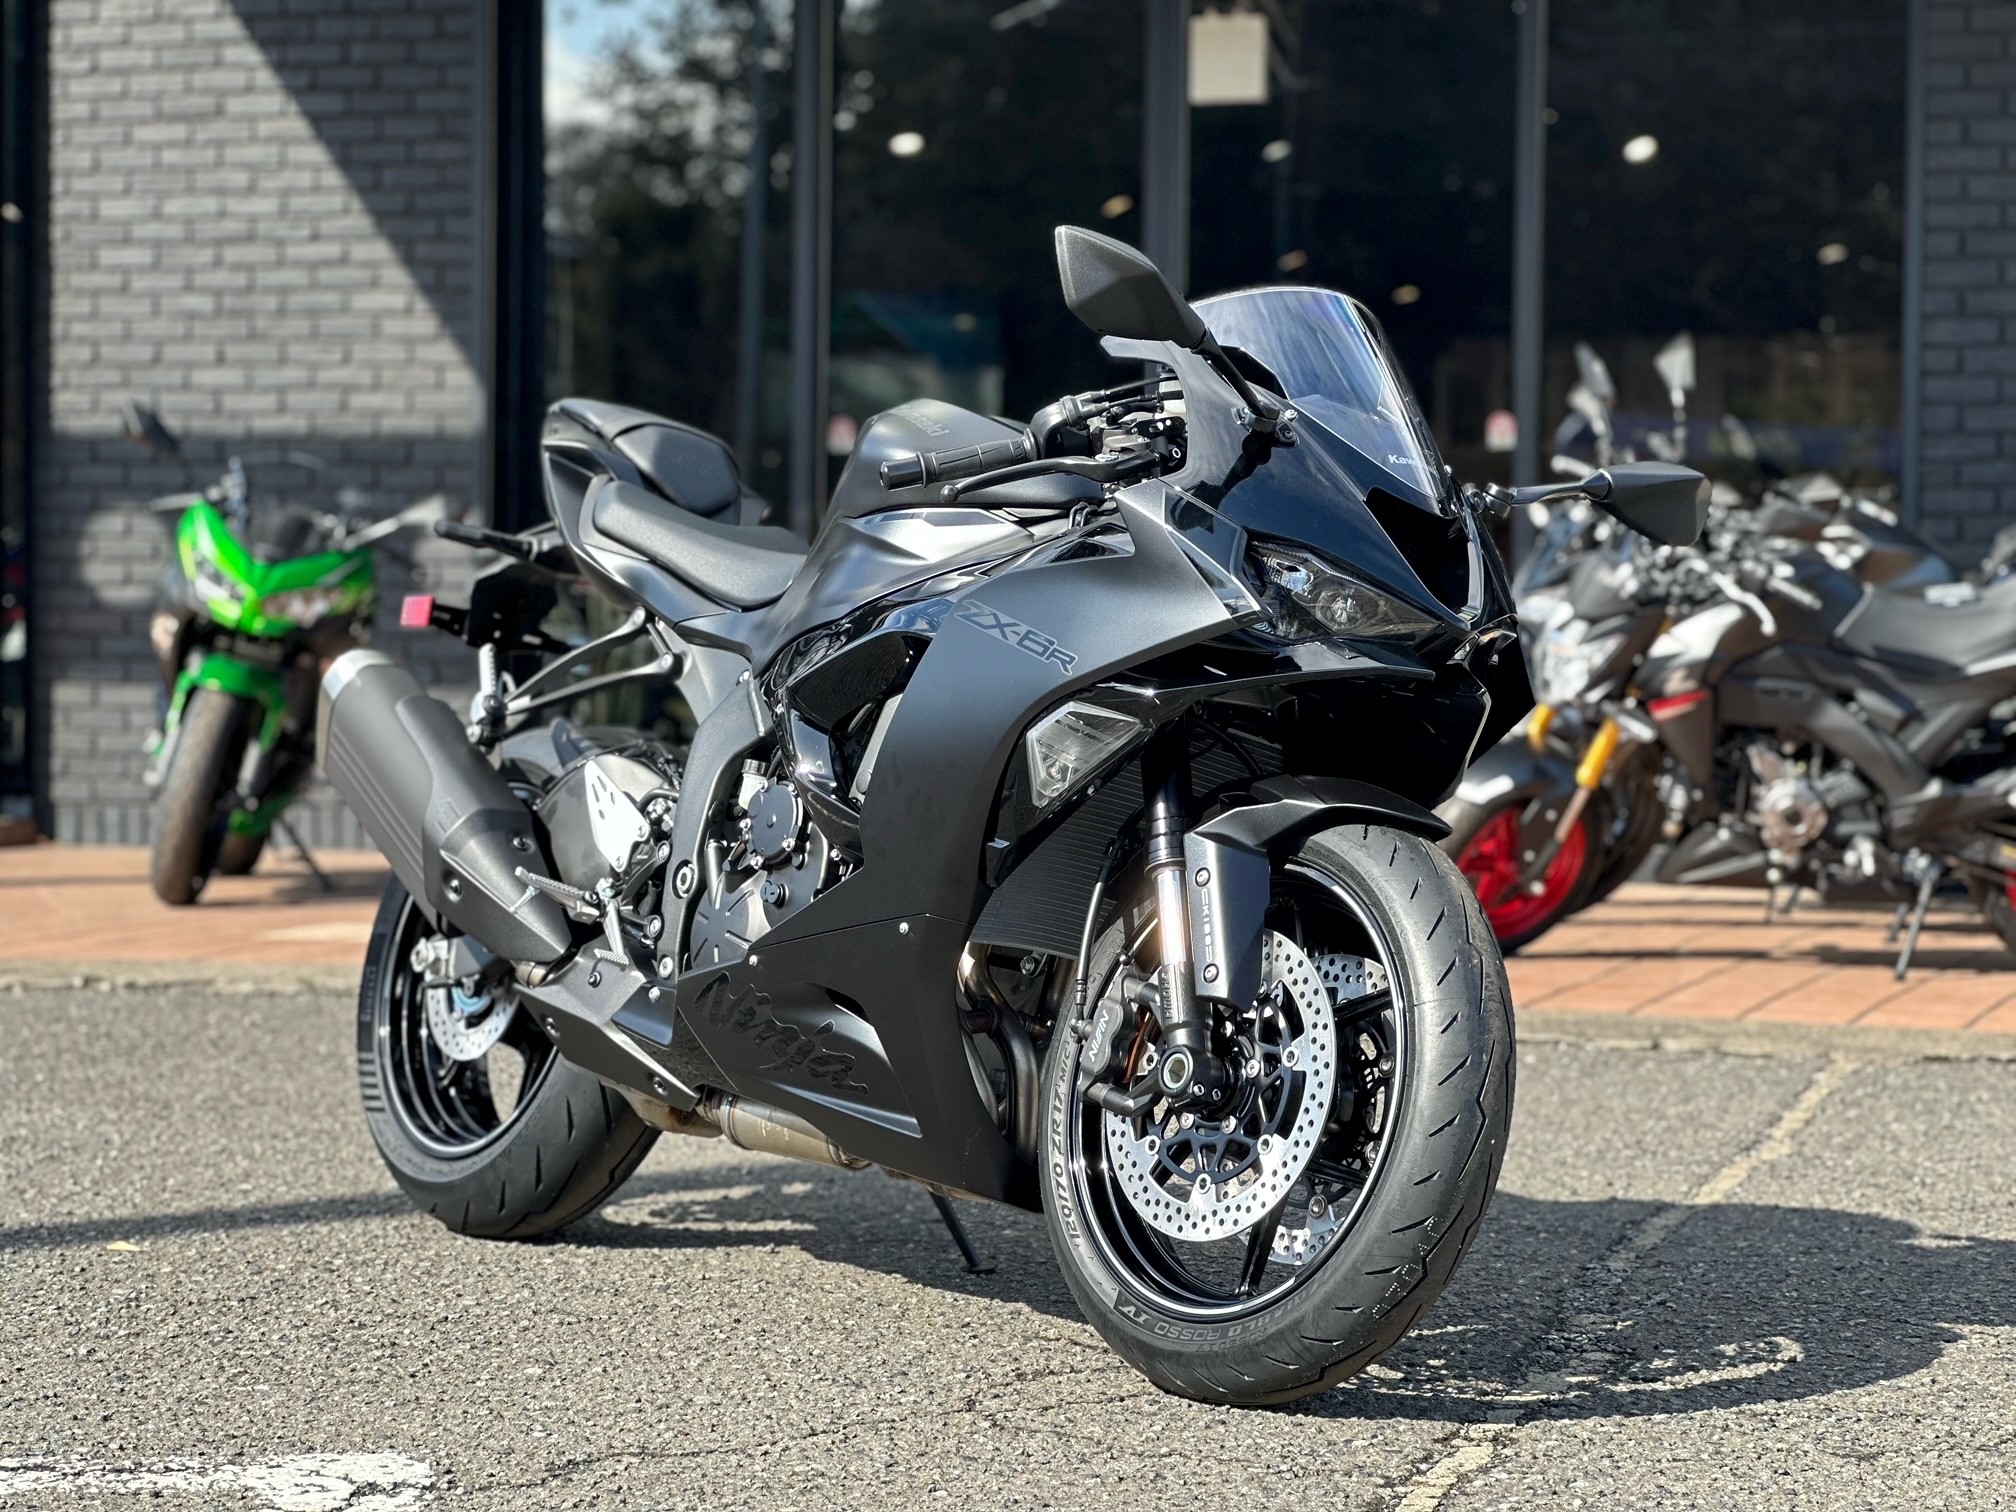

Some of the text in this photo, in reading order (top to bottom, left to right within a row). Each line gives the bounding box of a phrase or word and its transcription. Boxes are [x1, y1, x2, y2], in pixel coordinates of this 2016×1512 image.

[1387, 454, 1418, 467] Kaw
[953, 599, 1079, 676] ZX-6R
[693, 970, 869, 1096] Ninja
[1117, 1304, 1152, 1325] IV
[1154, 1321, 1221, 1340] ROSSO
